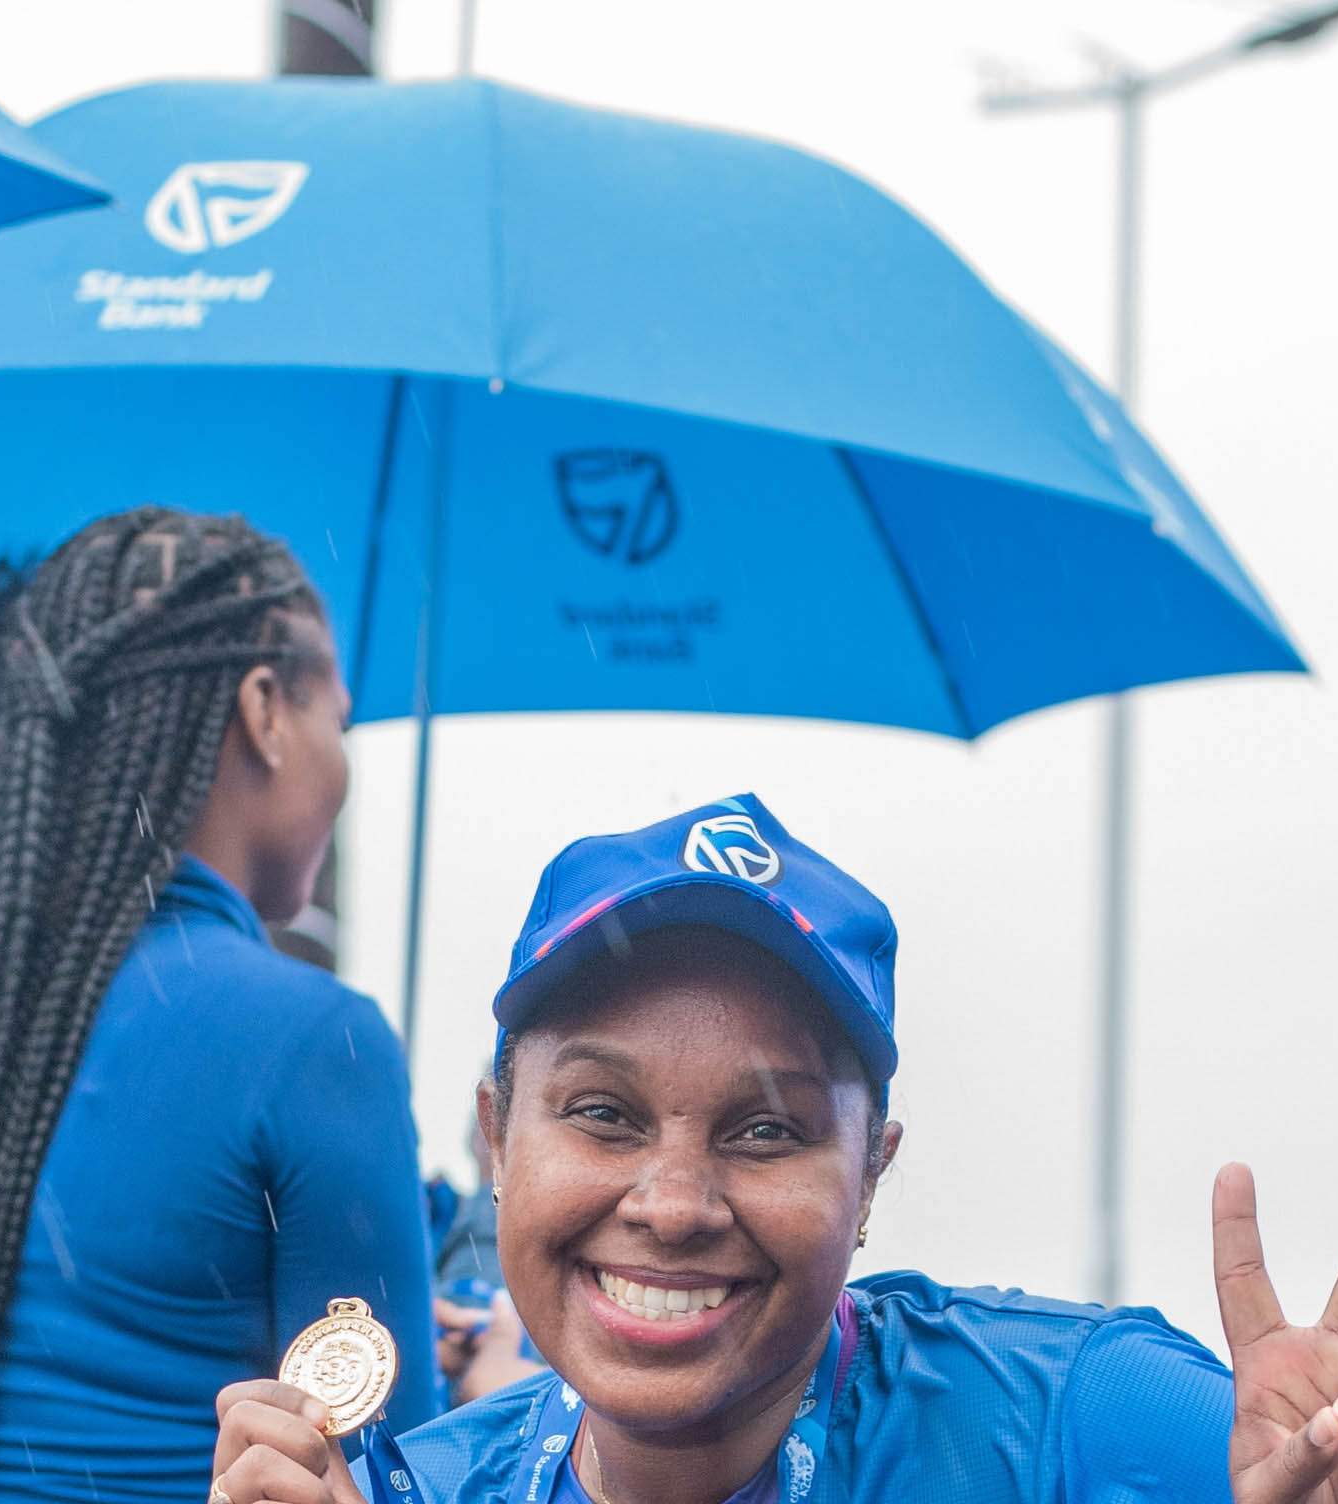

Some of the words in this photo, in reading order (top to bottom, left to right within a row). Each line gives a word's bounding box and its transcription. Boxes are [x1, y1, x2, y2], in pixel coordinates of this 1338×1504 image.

[74, 269, 273, 302] Standard
[98, 298, 209, 330] Bank
[525, 1456, 550, 1502] Standard
